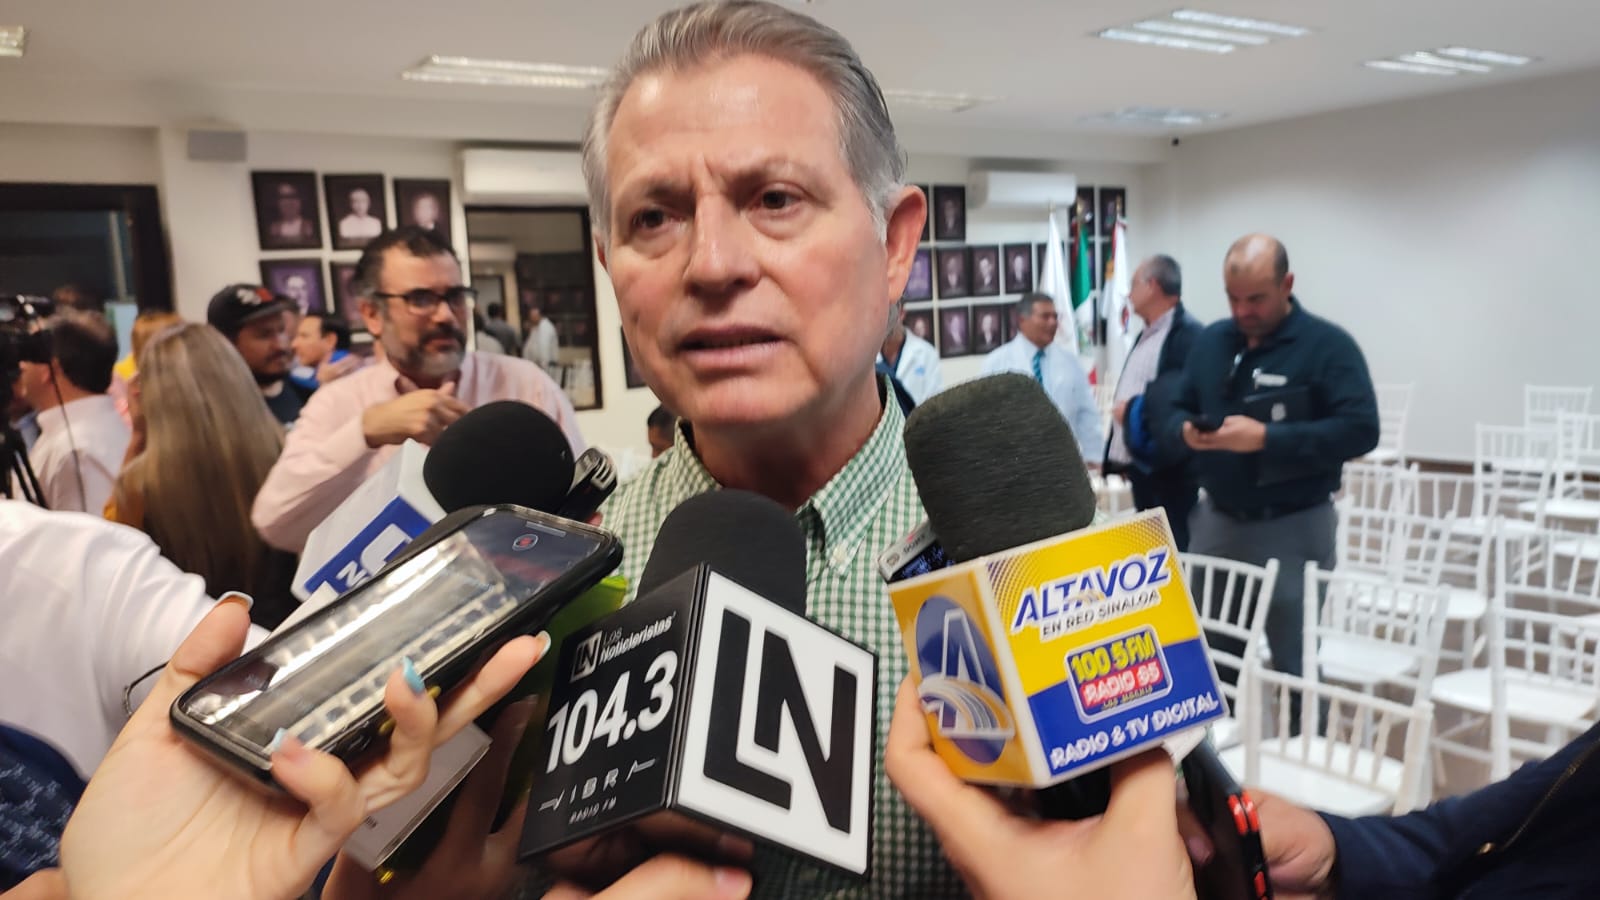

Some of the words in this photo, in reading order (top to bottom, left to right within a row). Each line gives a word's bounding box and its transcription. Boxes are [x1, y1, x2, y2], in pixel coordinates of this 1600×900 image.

[1014, 552, 1169, 628] ALTAVOZ
[1042, 620, 1062, 637] EN
[1066, 610, 1095, 629] RED
[1098, 589, 1161, 616] SINALOA
[545, 650, 679, 774] 104.3
[703, 606, 858, 835] LN
[1083, 669, 1136, 707] RADIO
[1050, 731, 1110, 770] RADIO
[1111, 725, 1126, 747] &
[1126, 714, 1150, 740] TV
[1150, 691, 1219, 732] DIGITAL
